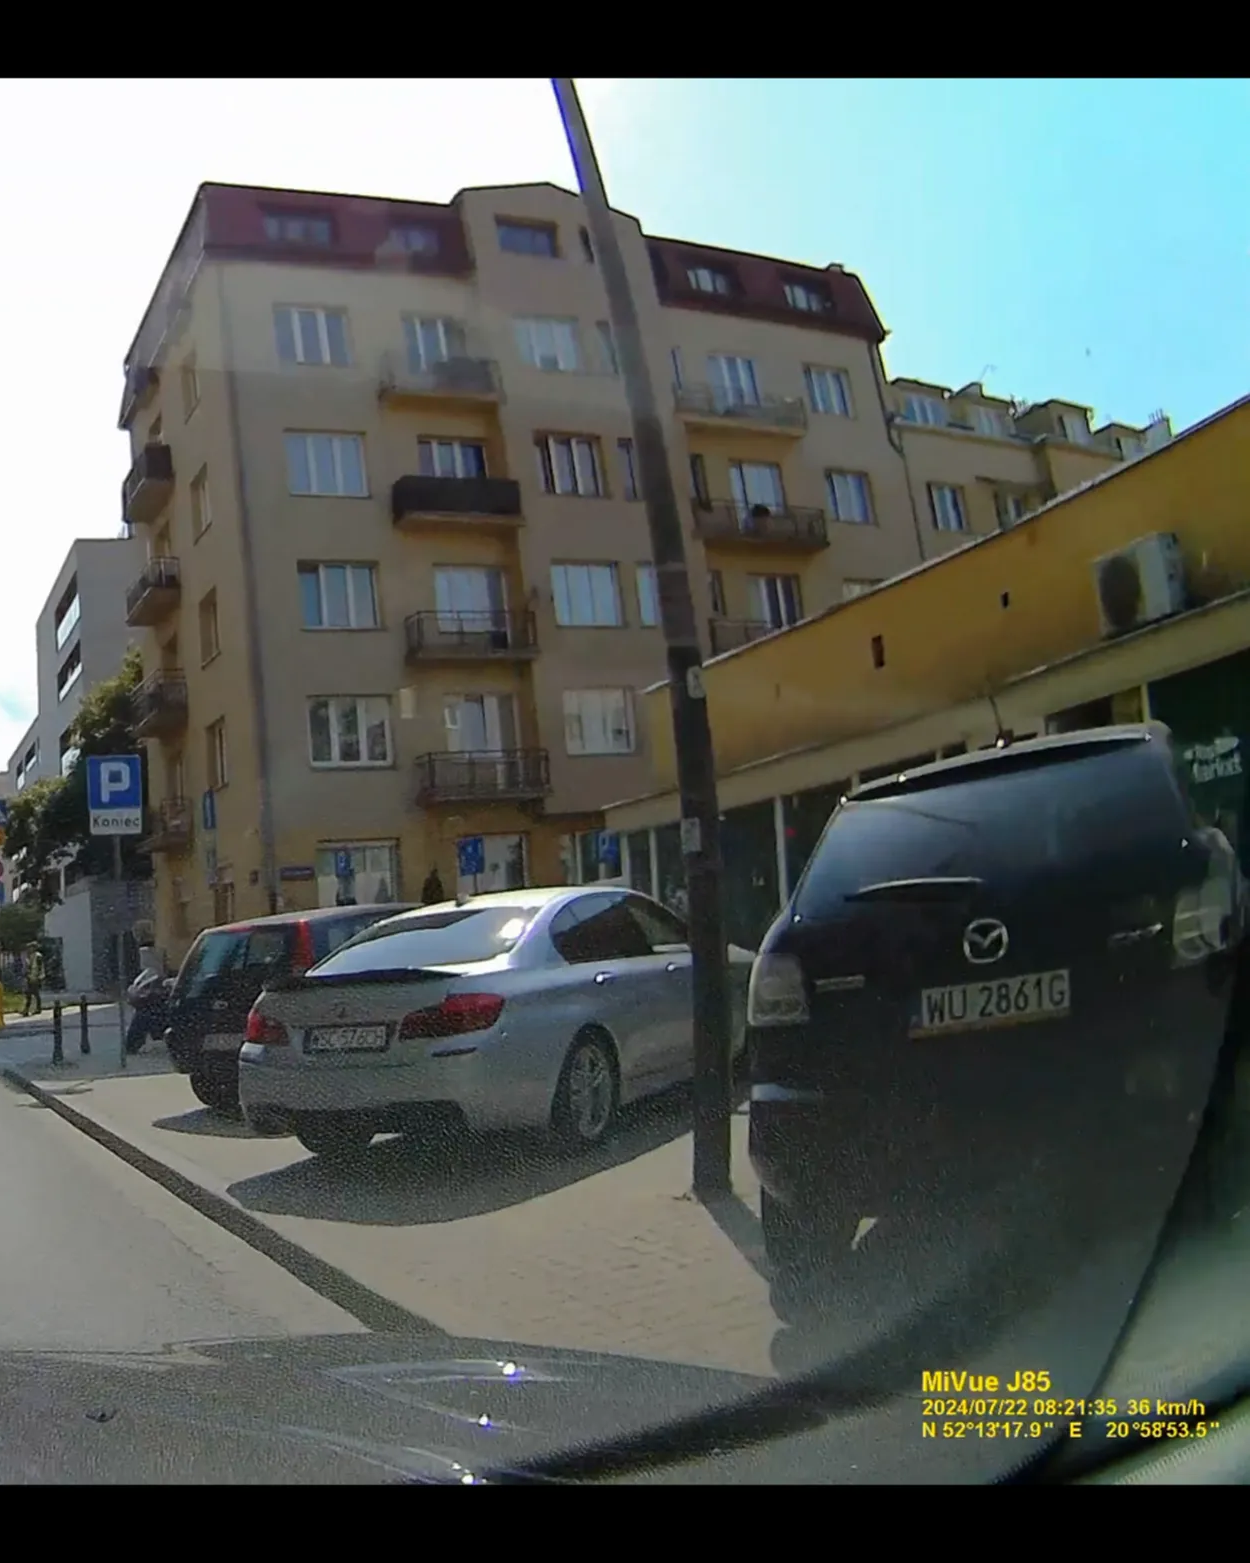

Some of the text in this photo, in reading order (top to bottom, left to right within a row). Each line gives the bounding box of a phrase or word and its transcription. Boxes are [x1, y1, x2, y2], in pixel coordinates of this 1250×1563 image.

[100, 762, 130, 804] P
[92, 815, 140, 829] Koniec
[926, 973, 1066, 1024] WU 2861G
